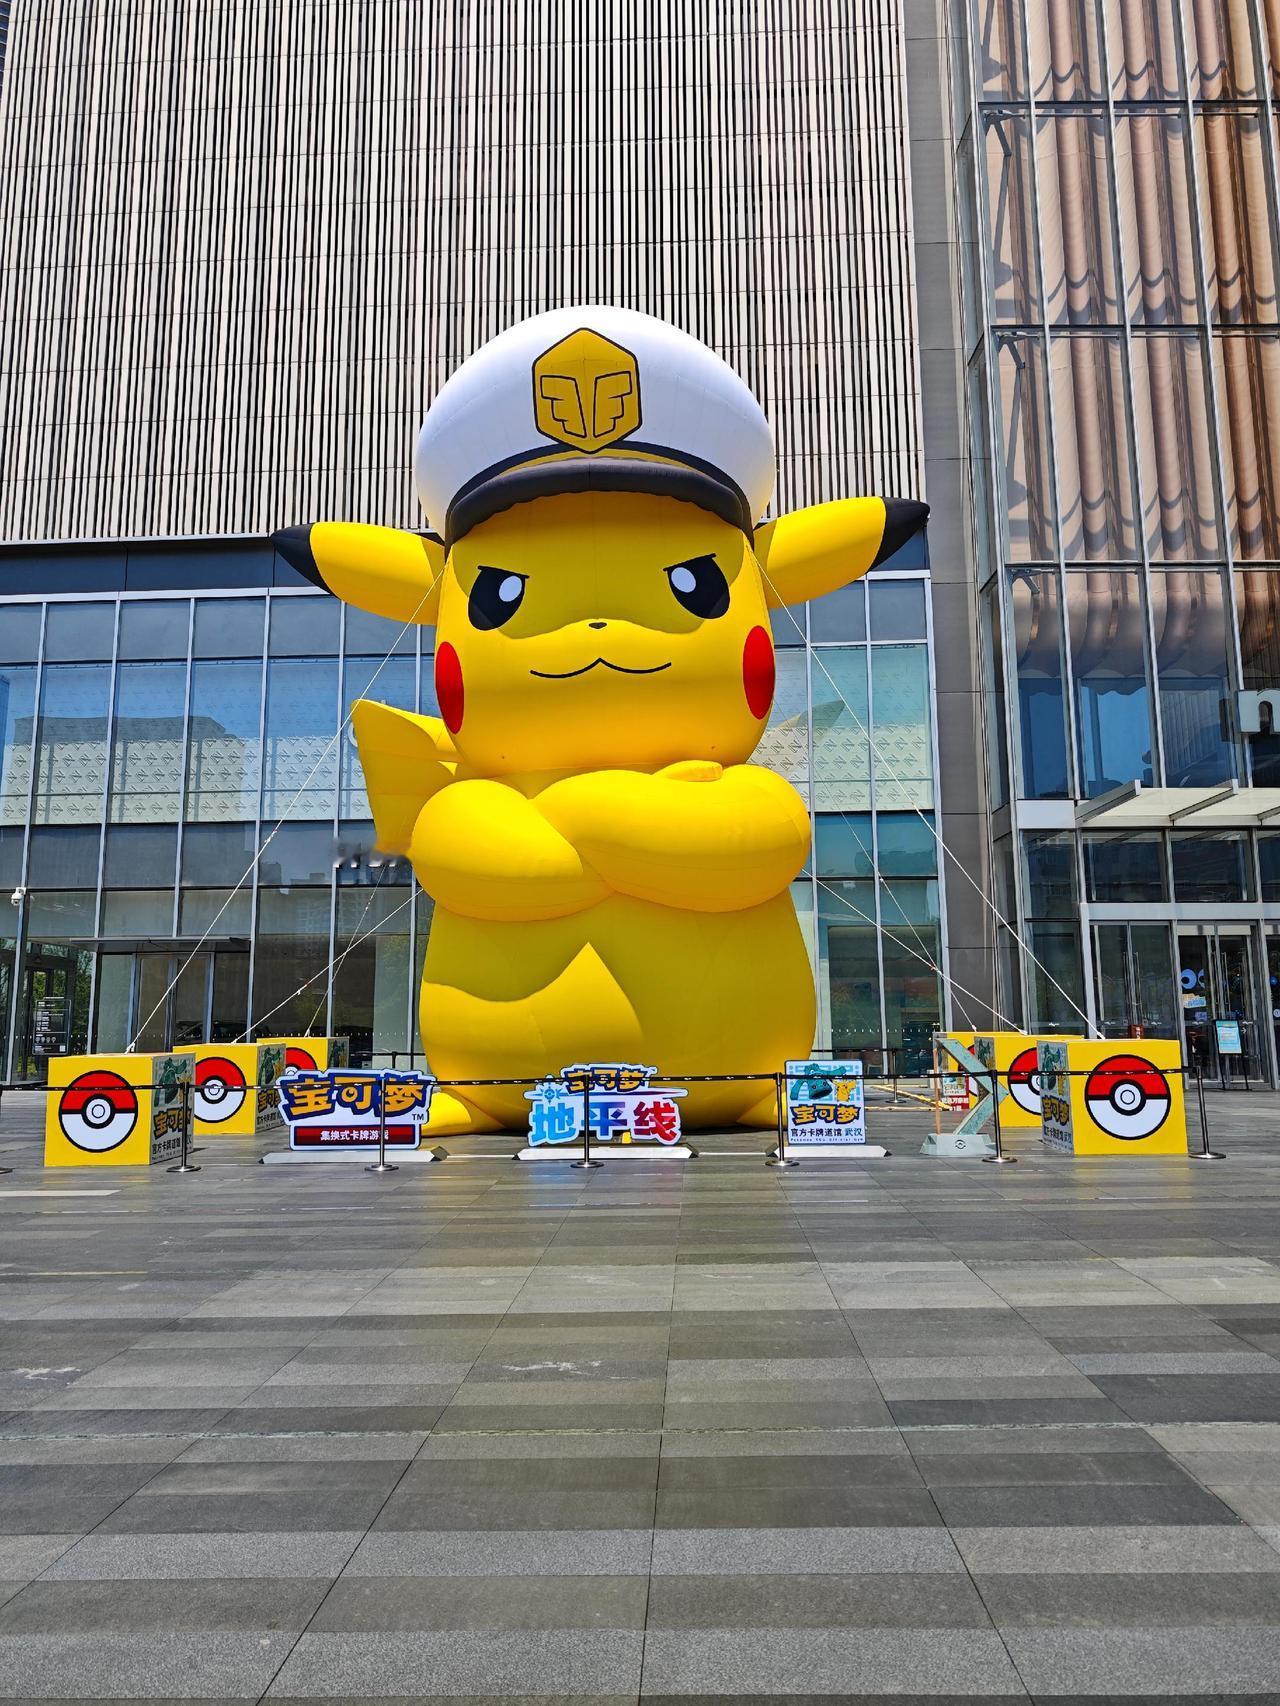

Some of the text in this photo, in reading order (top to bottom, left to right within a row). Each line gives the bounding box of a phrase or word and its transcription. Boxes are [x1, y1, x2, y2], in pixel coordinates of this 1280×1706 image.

[562, 1066, 649, 1094] 宝可梦
[283, 1075, 425, 1118] 宝可梦
[411, 1113, 424, 1121] TM
[531, 1101, 678, 1142] 地平线
[790, 1104, 861, 1125] 宝可梦
